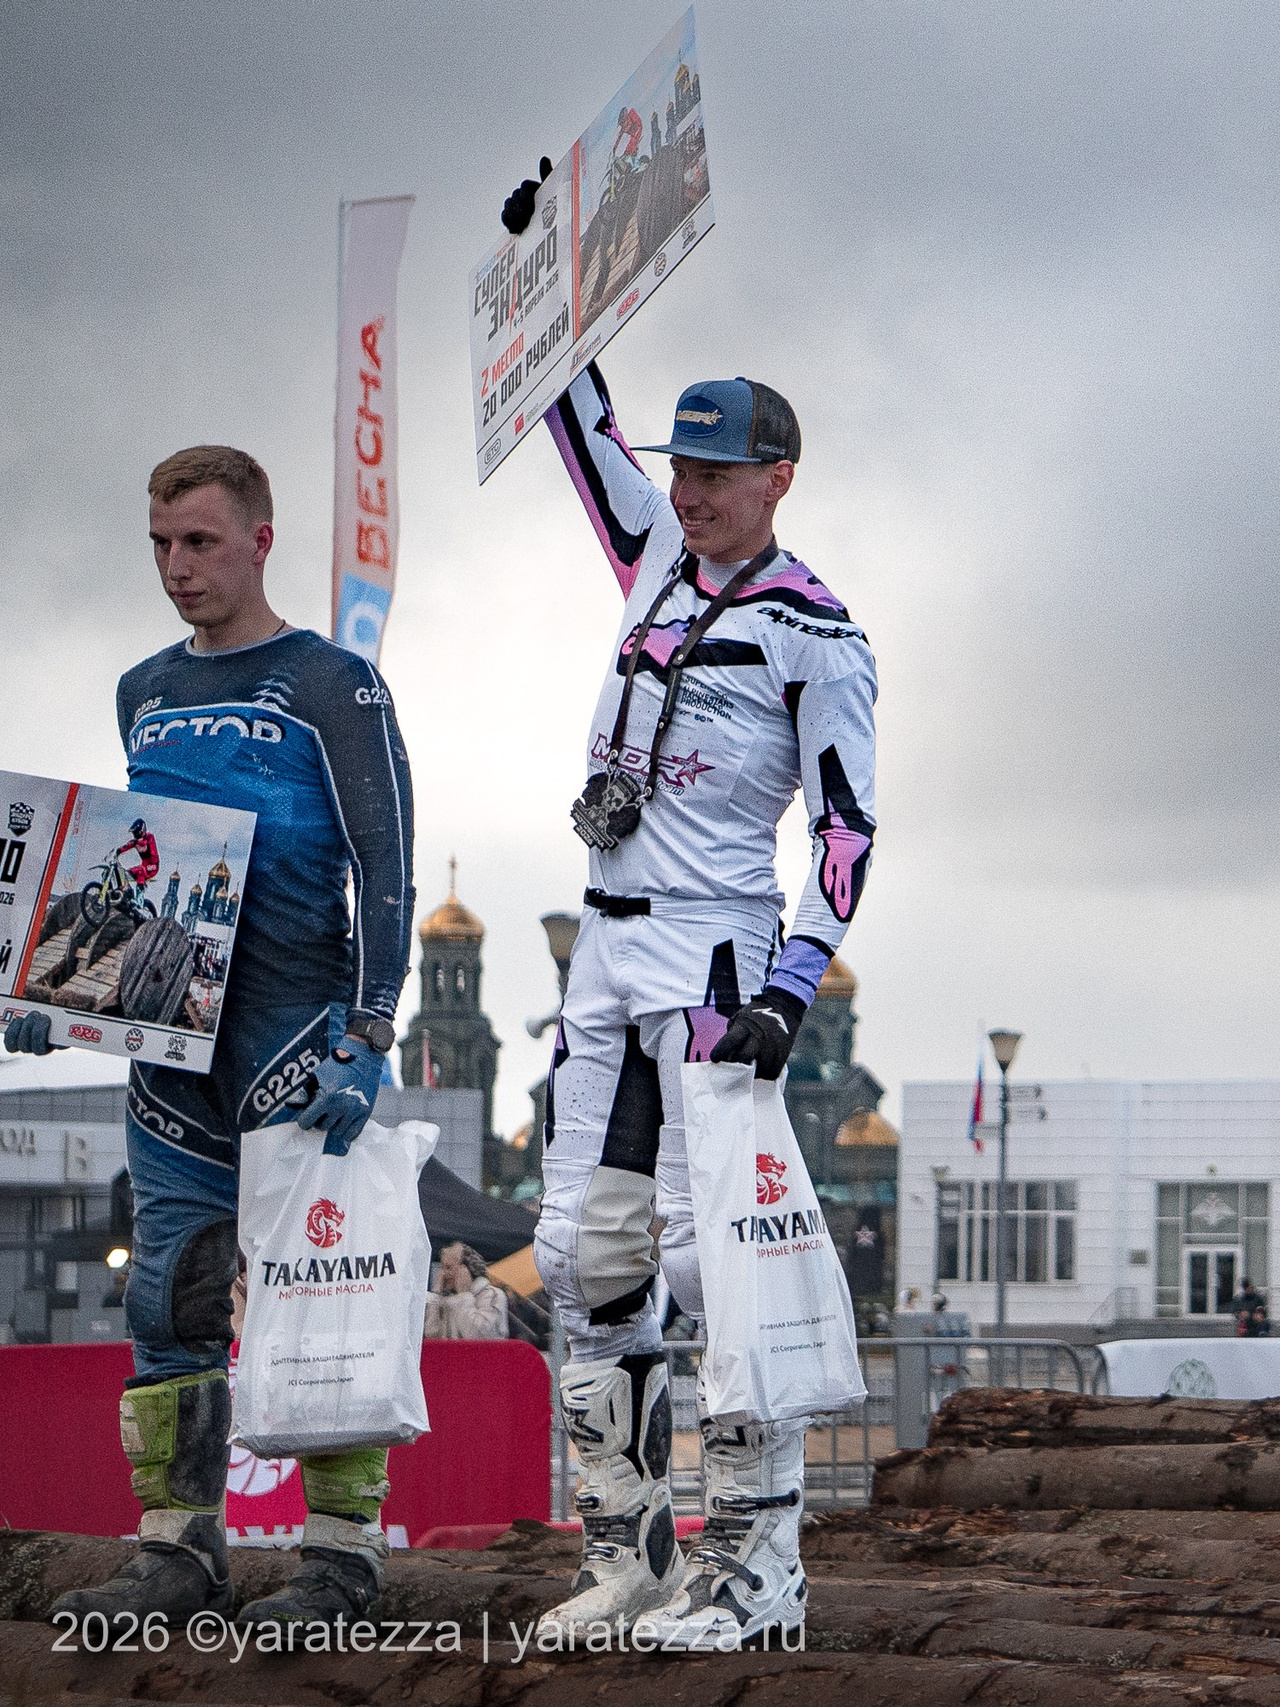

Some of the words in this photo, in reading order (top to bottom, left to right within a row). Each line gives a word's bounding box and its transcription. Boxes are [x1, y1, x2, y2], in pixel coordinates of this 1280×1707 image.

[474, 243, 516, 318] СУПЕР
[488, 225, 558, 342] ЭНДУРО
[481, 366, 489, 398] 2
[491, 332, 524, 387] МЕСТО
[482, 389, 497, 429] 20
[501, 369, 522, 409] 000
[526, 302, 570, 378] РУБЛЕЙ
[355, 315, 391, 570] ВЕСНА
[680, 695, 732, 720] PRODUCTION
[0, 891, 15, 905] 026
[253, 1048, 321, 1112] G225
[757, 1245, 791, 1259] ОРНЫЕ
[335, 1283, 375, 1295] МАСЛА
